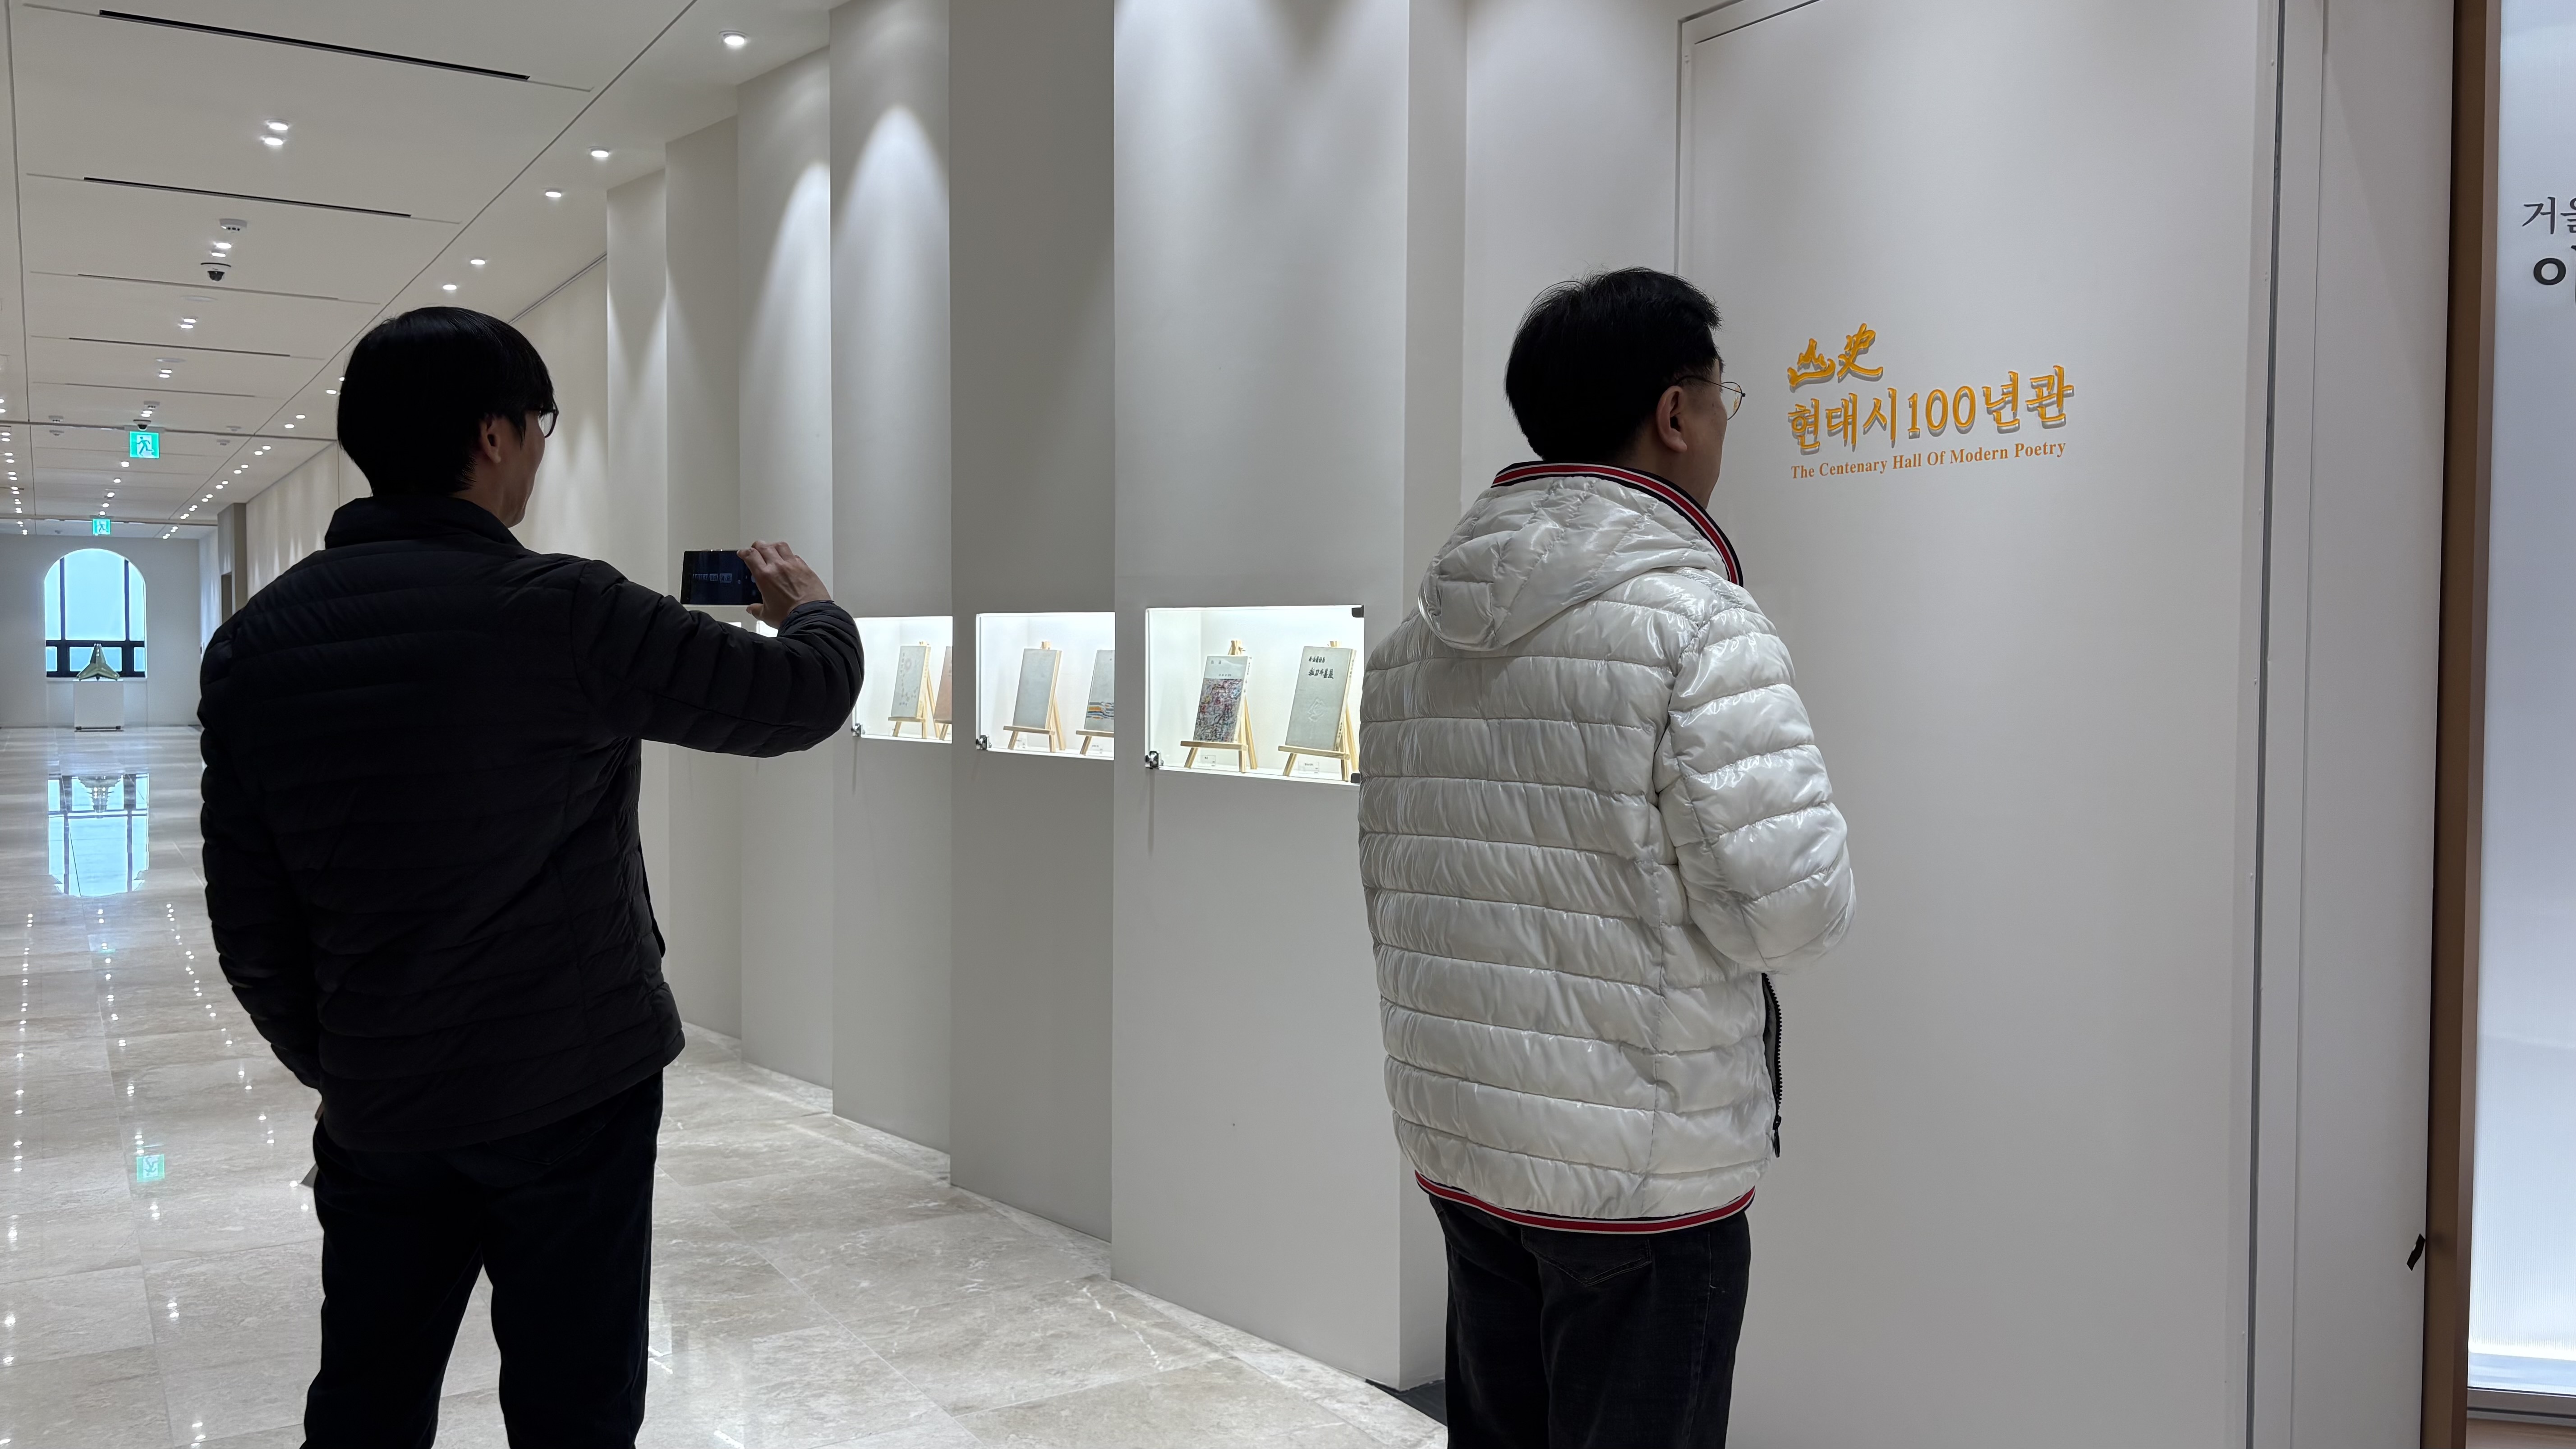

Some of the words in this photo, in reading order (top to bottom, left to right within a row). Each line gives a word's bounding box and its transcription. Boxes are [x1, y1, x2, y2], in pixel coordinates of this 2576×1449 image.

[1787, 323, 1884, 389] 山史
[1787, 365, 2074, 451] 현대시100년관
[1791, 465, 1815, 479] The
[1819, 460, 1887, 476] Centenary
[1892, 453, 1922, 469] Hall
[1927, 451, 1946, 466] Of
[1950, 447, 2008, 464] Modern
[2014, 442, 2066, 458] Poetry
